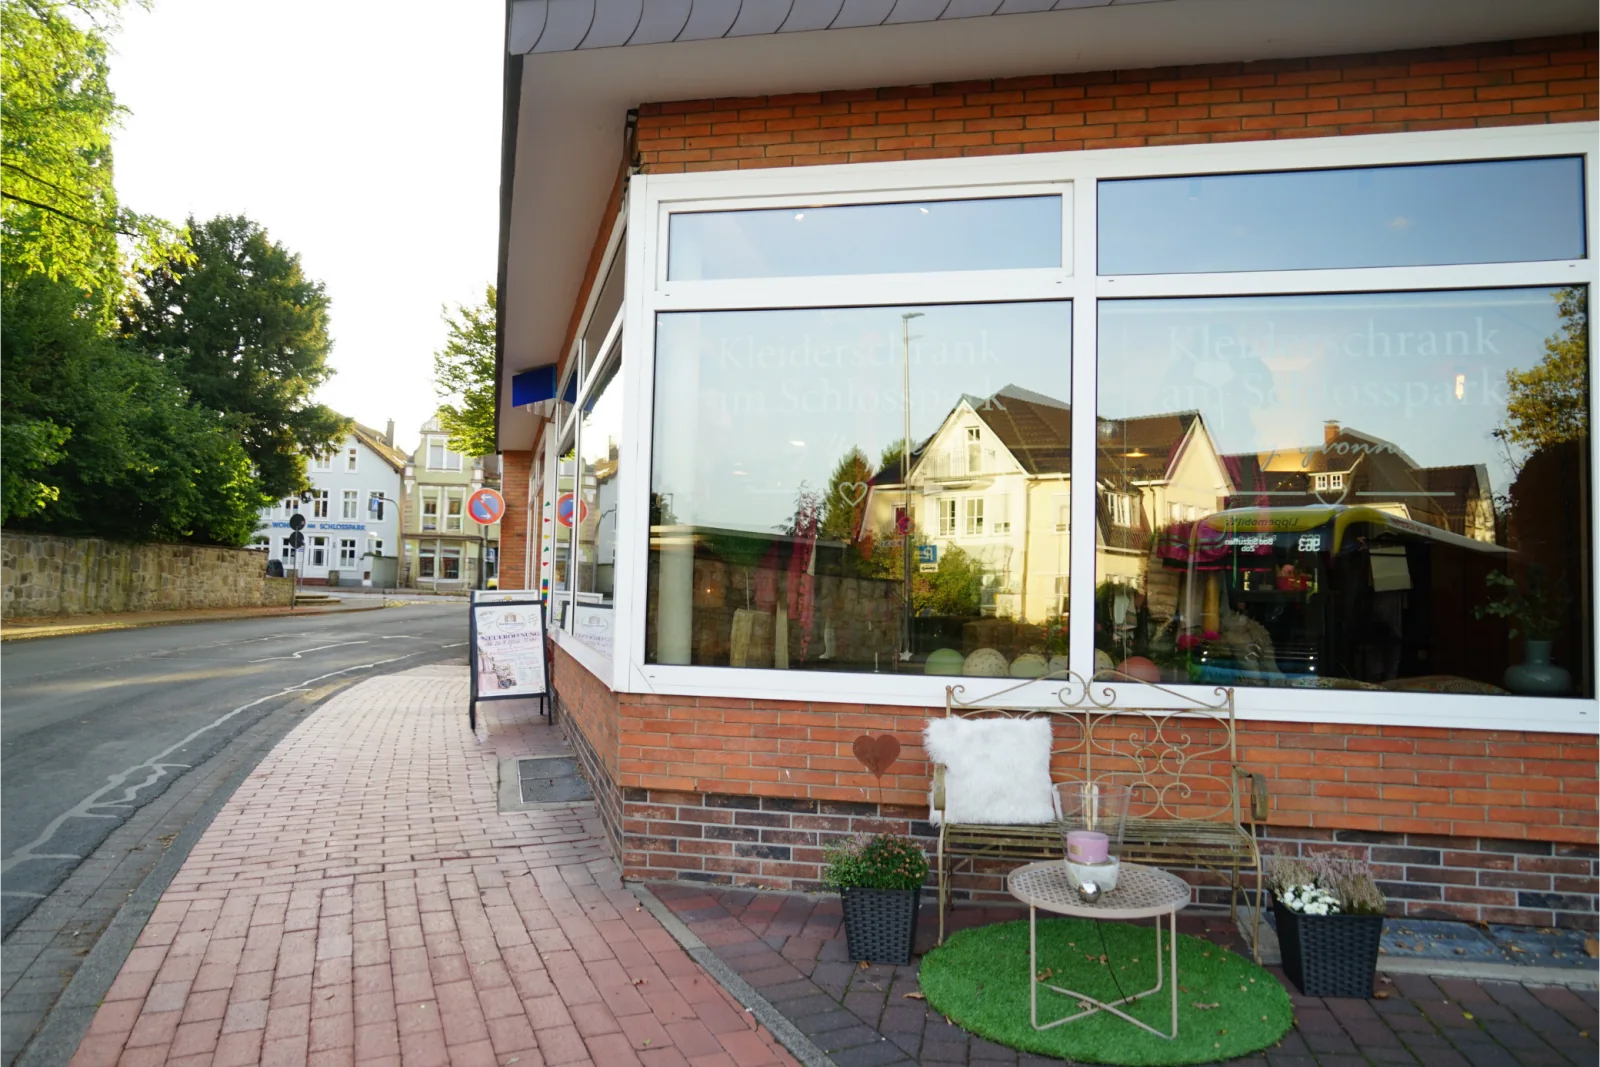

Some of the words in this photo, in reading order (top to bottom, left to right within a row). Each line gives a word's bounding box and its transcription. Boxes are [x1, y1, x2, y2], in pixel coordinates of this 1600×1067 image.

[720, 330, 1002, 370] Kleiderschrank
[1168, 315, 1502, 362] Kleiderschrank
[782, 376, 1005, 419] Schlosspk
[320, 523, 366, 531] SCHLOSSPARK
